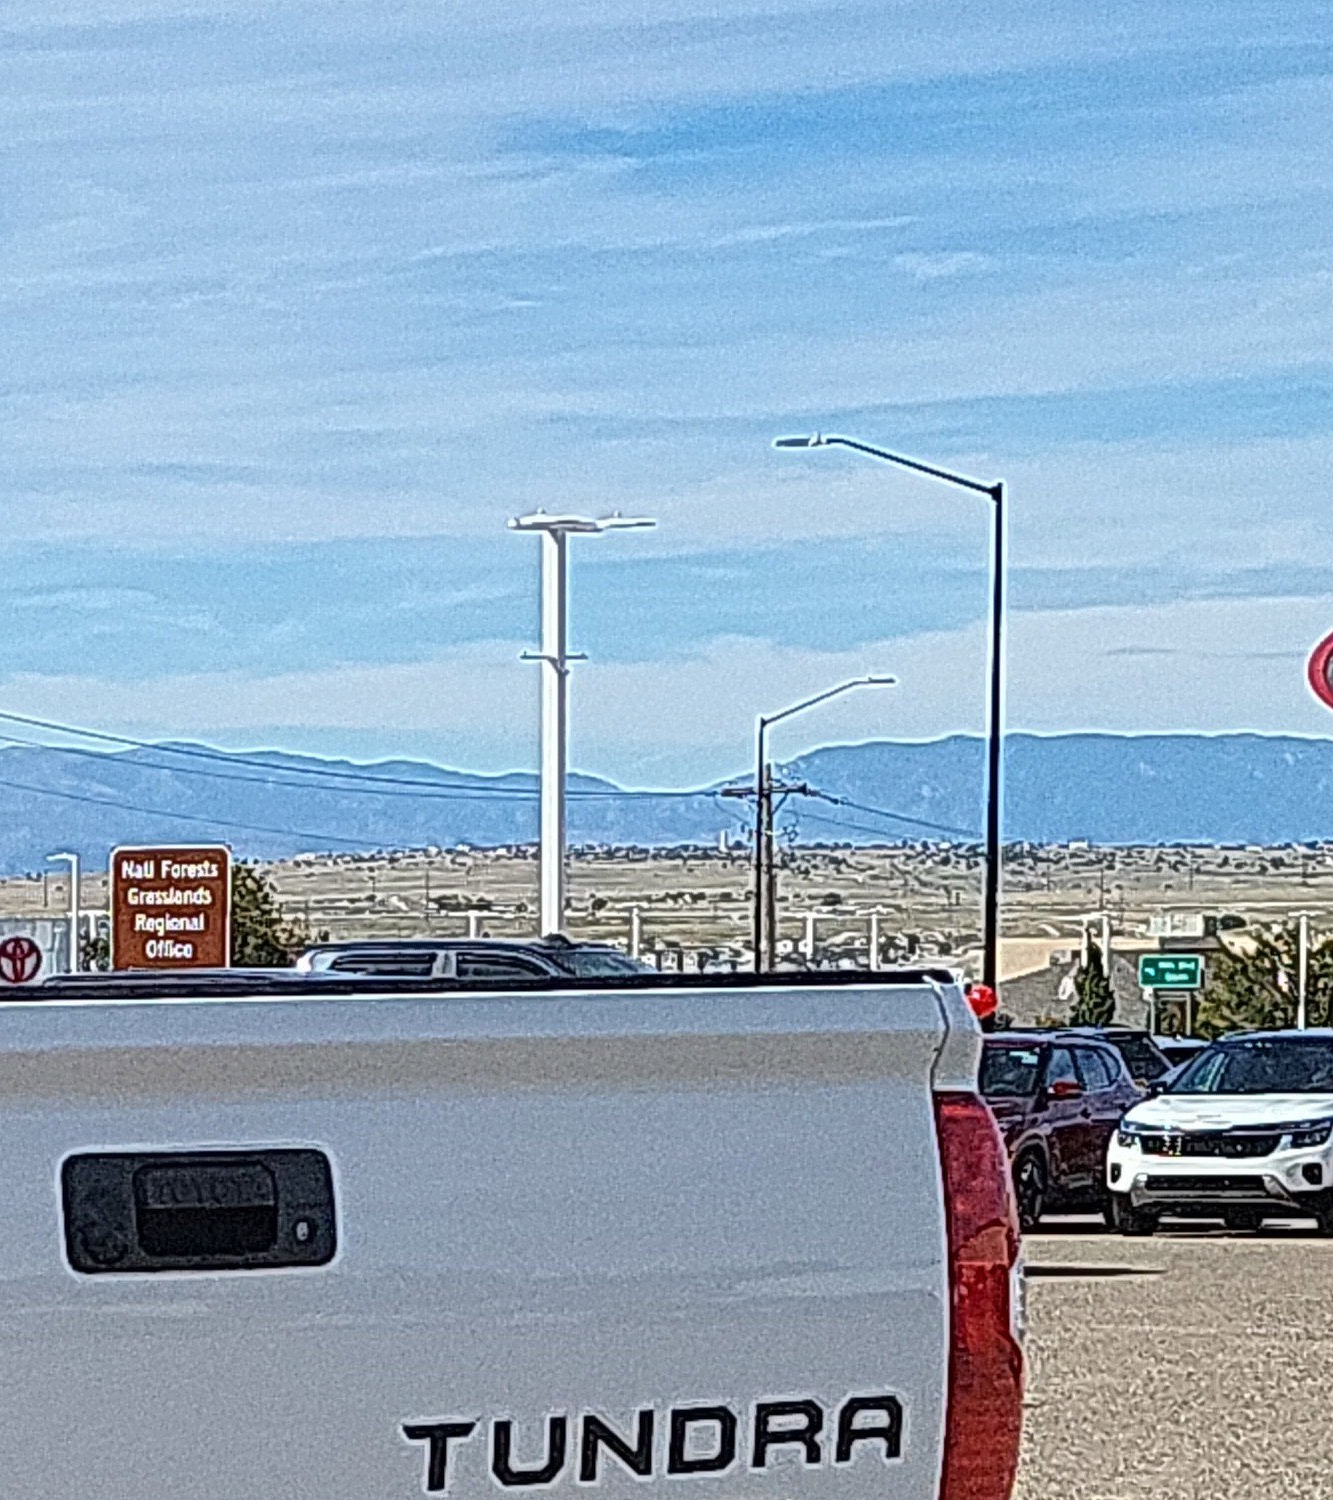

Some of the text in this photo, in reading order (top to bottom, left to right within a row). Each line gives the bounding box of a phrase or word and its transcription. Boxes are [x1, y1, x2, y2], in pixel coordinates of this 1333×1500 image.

[161, 860, 219, 879] Forests
[127, 886, 213, 906] Grasslands
[134, 912, 205, 936] Regional
[145, 939, 193, 959] Office
[401, 1394, 903, 1493] TUNDRA
